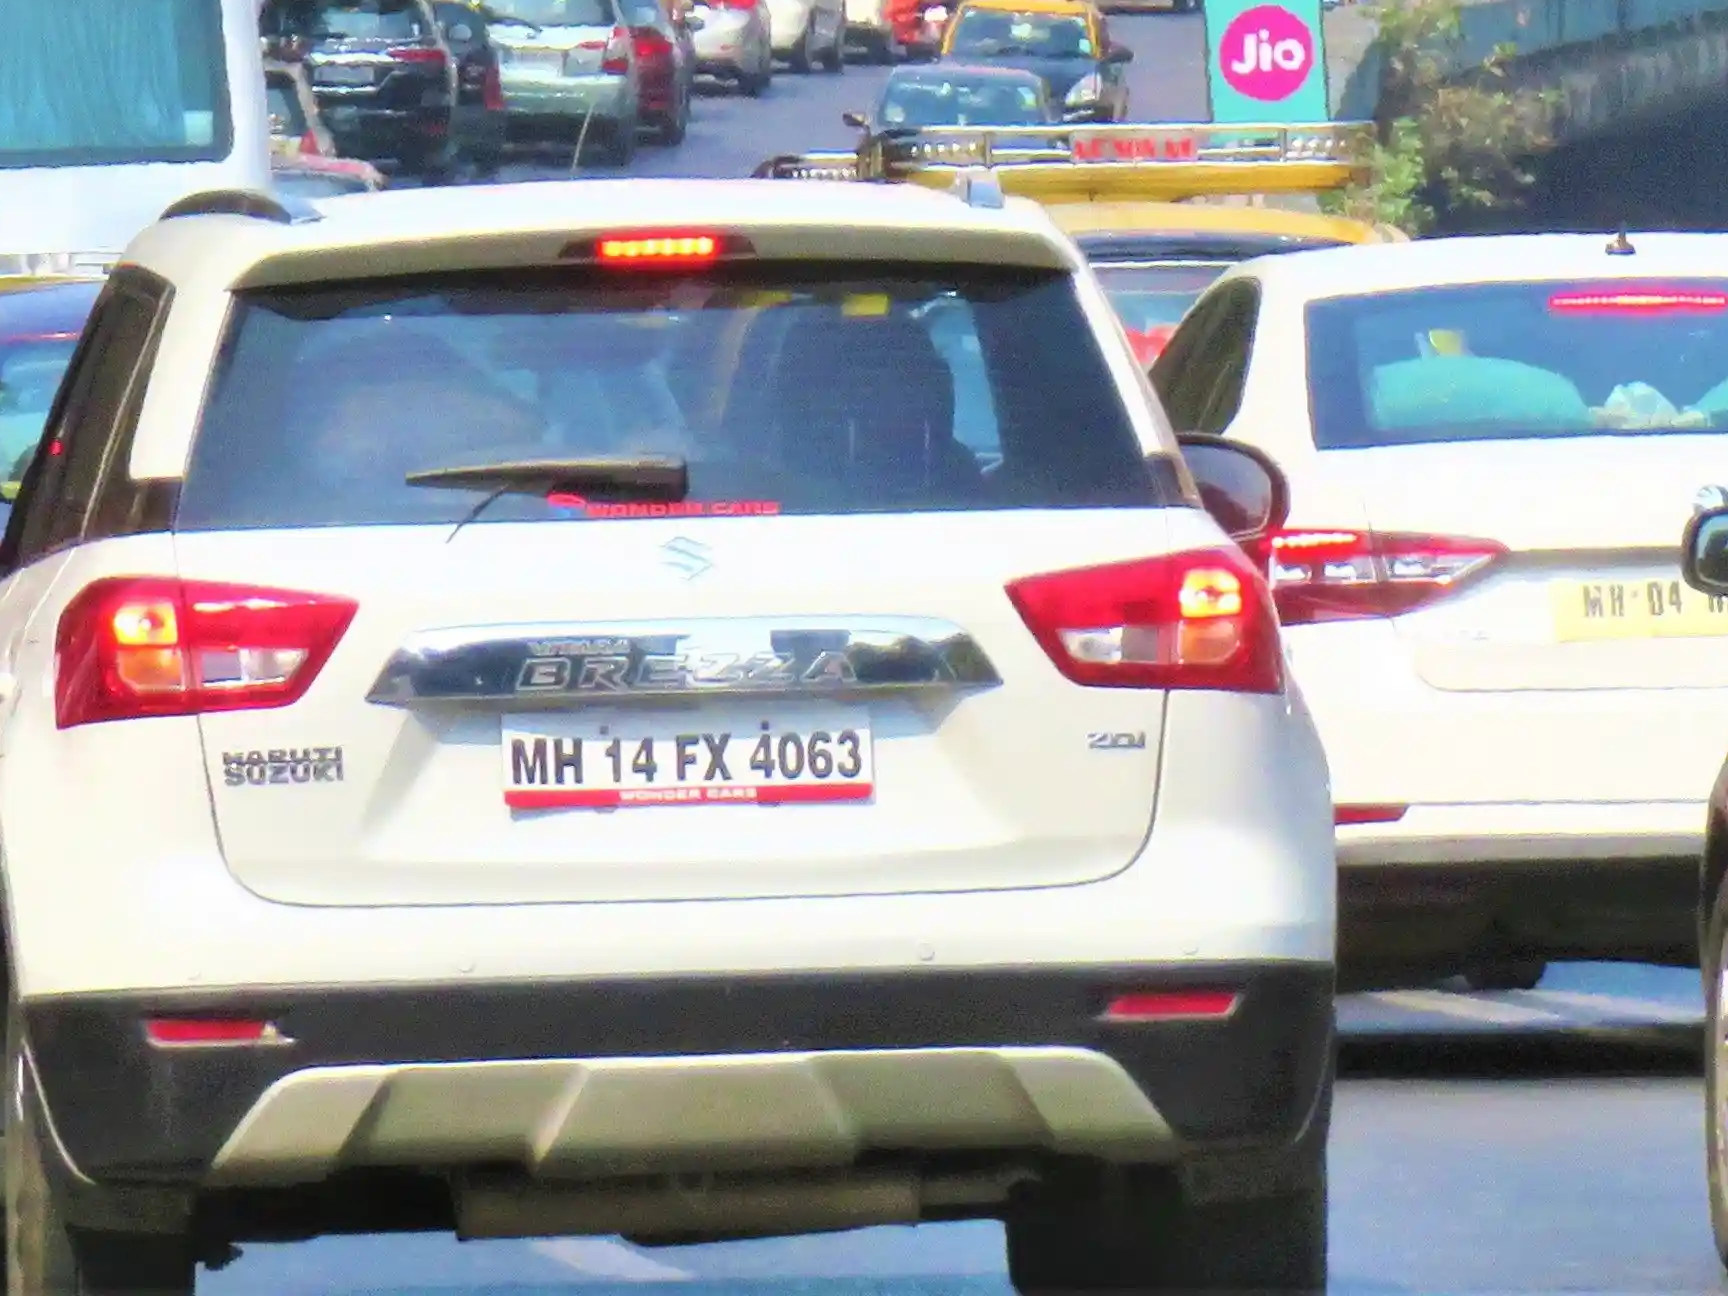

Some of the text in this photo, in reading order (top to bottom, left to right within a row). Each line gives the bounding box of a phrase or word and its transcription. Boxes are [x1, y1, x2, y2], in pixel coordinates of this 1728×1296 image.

[1231, 28, 1305, 74] Jio
[515, 651, 860, 693] BREZZA
[222, 760, 344, 786] SUZUKI
[511, 729, 863, 785] MH 14 FX 4063
[705, 785, 759, 801] CARS
